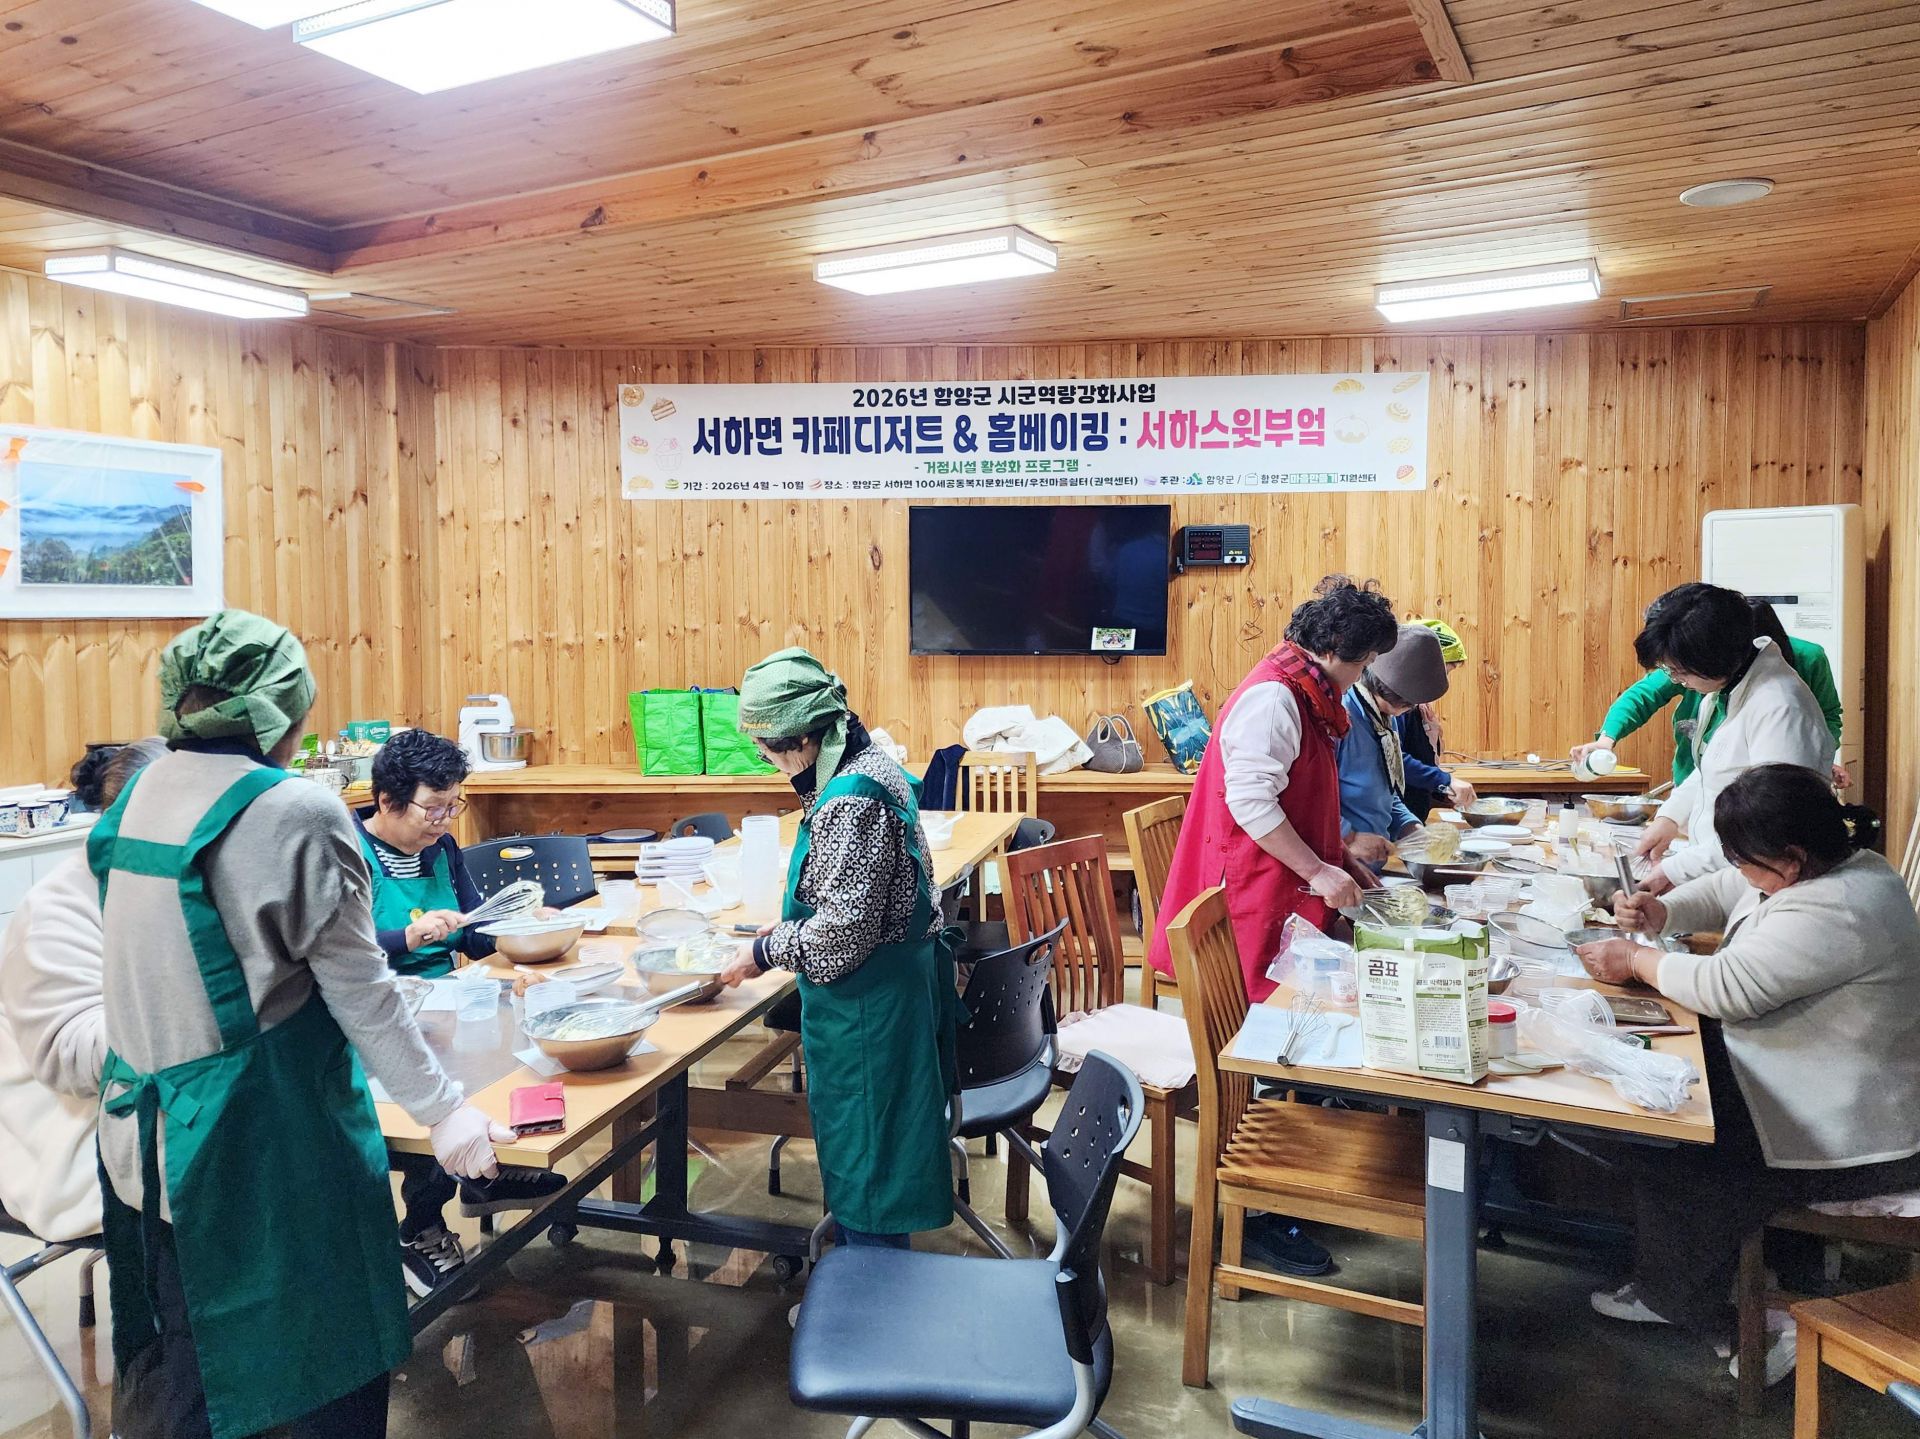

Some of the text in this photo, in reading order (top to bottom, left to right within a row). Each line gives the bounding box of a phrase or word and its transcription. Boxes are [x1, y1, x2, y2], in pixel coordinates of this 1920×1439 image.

[852, 383, 1156, 408] 2026년 함양군 시군역량강화사업
[692, 416, 783, 456] 서하면
[792, 415, 944, 455] 카페디저트
[953, 414, 979, 454] &
[987, 412, 1109, 453] 홈베이킹
[1136, 407, 1326, 450] 서하스윗부엌
[923, 460, 977, 475] 거점시설
[980, 459, 1022, 474] 활성화
[1024, 458, 1079, 473] 프로그램
[683, 481, 703, 491] 기간
[711, 481, 750, 491] 2026년
[752, 481, 770, 491] 4월
[781, 480, 804, 490] 10월
[824, 480, 844, 490] 장소
[852, 480, 882, 490] 함양군
[884, 479, 914, 489] 서하면
[1159, 475, 1180, 486] 주관
[1206, 475, 1234, 486] 함양군
[1368, 959, 1399, 978] 곰표
